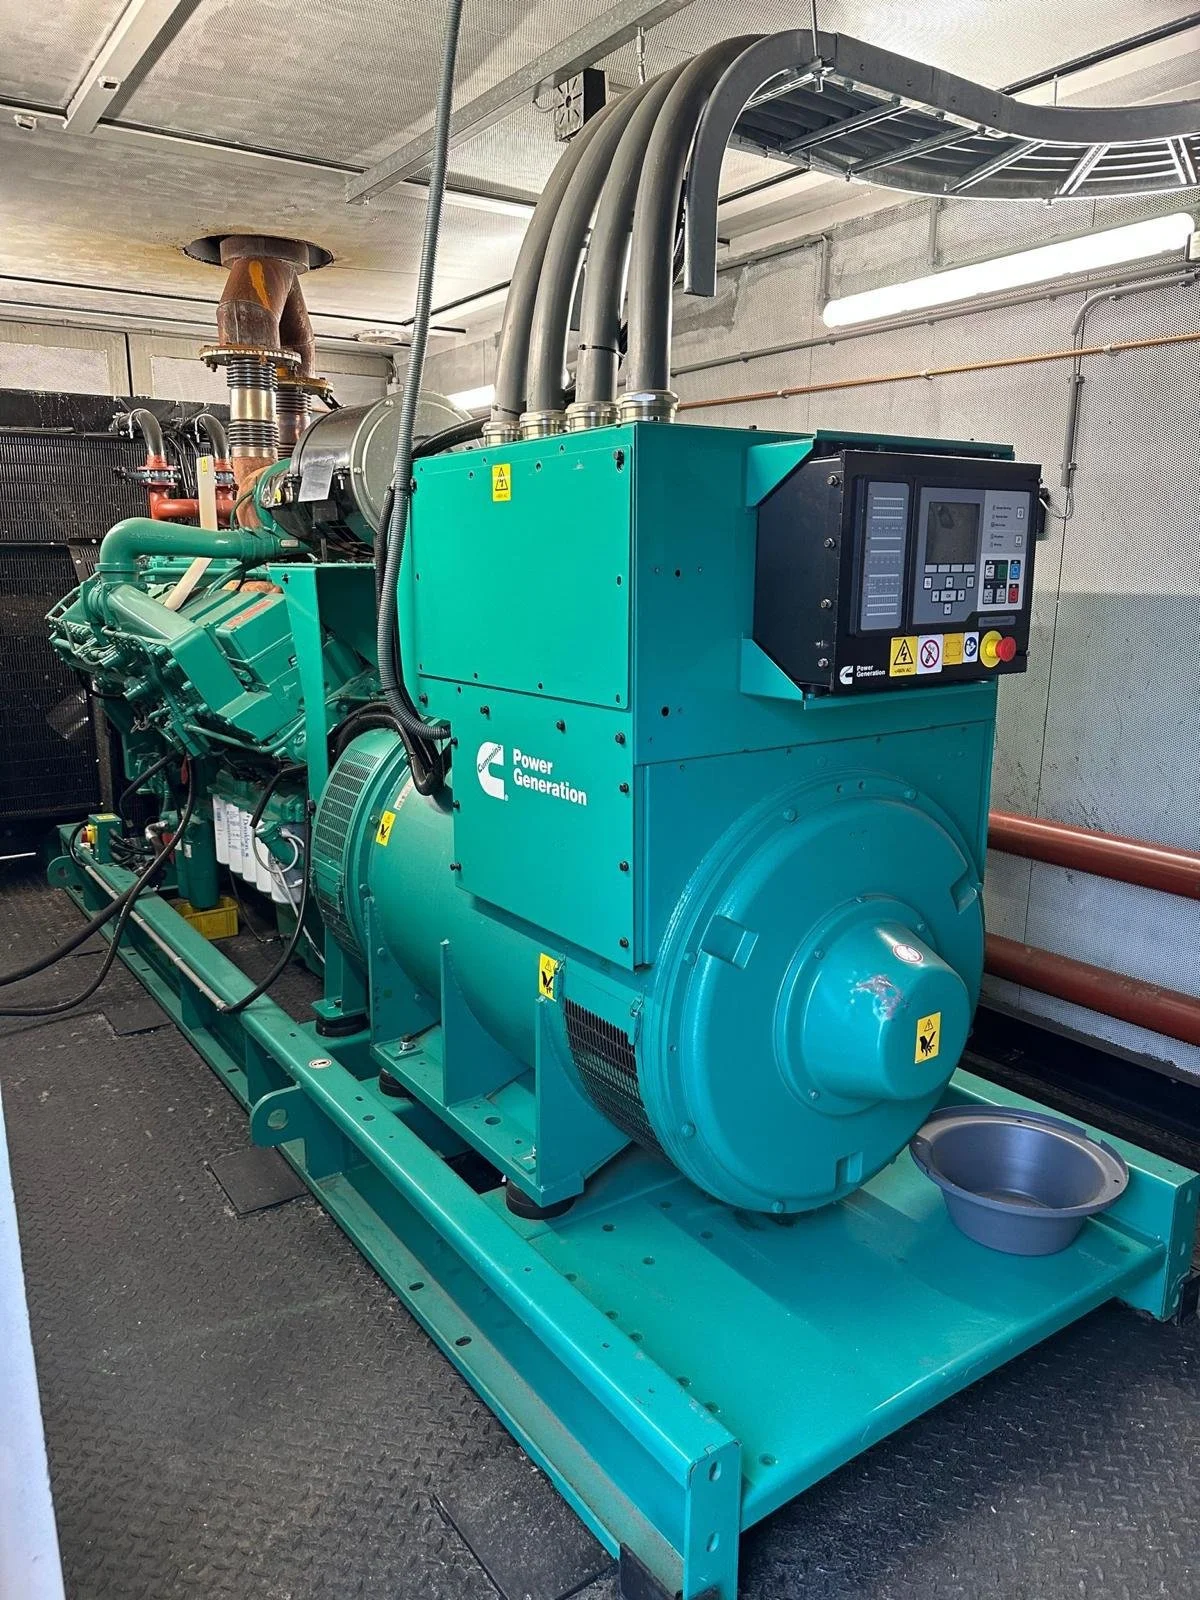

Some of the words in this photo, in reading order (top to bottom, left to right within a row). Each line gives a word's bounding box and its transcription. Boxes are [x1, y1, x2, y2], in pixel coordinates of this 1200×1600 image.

[477, 745, 502, 773] Cummins
[512, 748, 553, 775] Power
[512, 767, 587, 806] Generation
